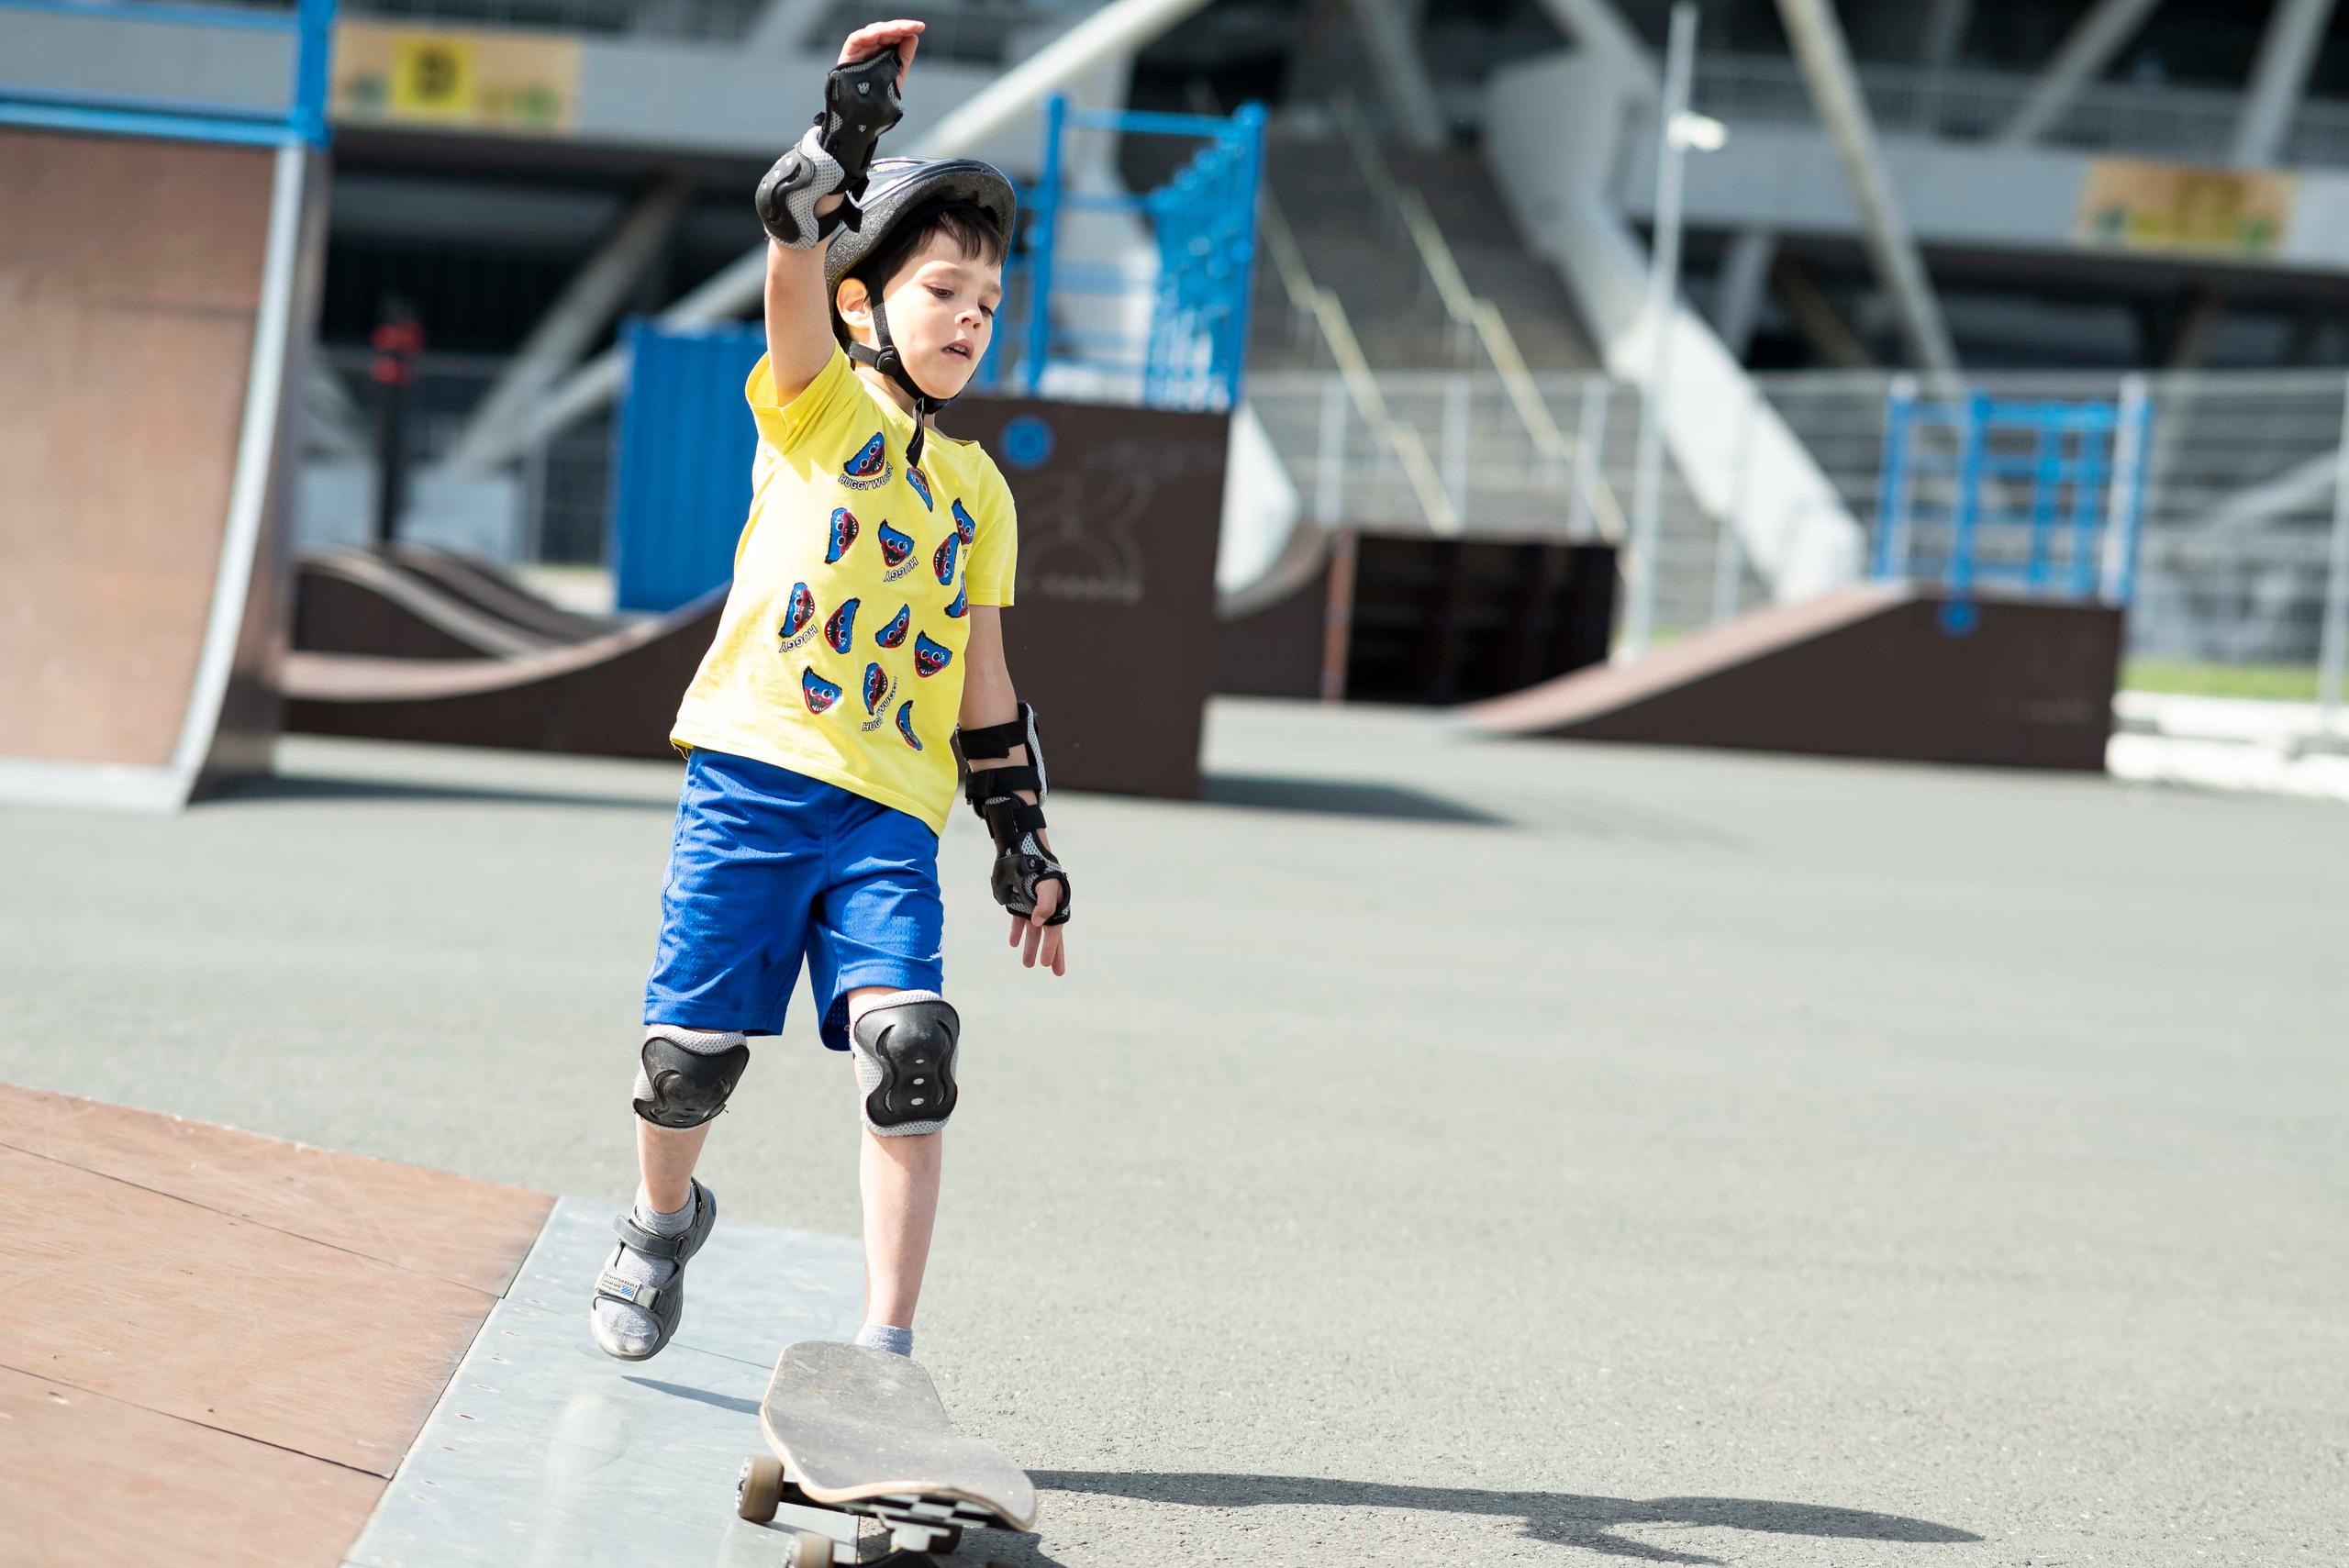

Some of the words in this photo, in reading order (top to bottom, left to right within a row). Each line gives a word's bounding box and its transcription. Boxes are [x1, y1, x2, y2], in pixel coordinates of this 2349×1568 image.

[838, 473, 870, 490] HUGGY
[871, 461, 894, 489] WUGY
[883, 555, 919, 583] HUGGY
[778, 624, 818, 653] HUGGY
[861, 716, 884, 731] HUG
